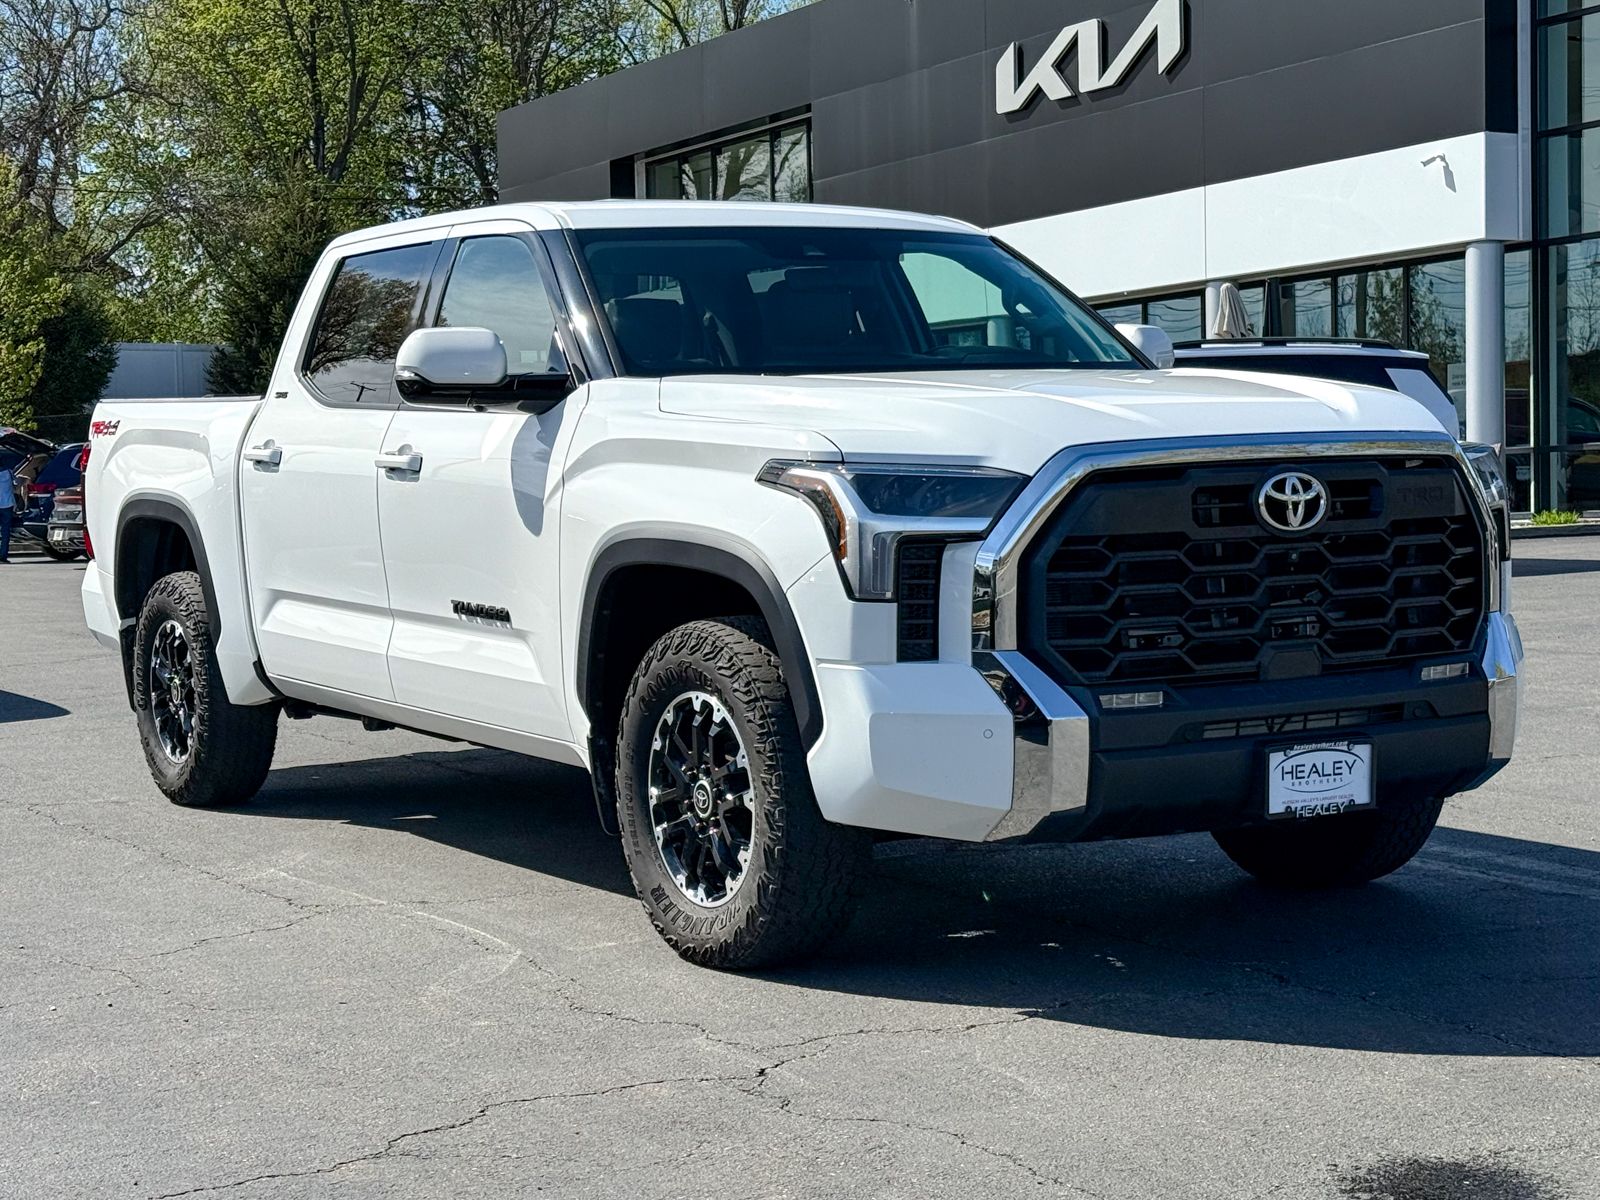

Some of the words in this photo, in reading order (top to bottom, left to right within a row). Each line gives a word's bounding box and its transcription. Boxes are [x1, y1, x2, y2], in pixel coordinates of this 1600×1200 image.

[996, 0, 1184, 114] KIA
[450, 599, 510, 623] TUNDRA
[1281, 759, 1357, 781] HEALEY
[1296, 803, 1346, 818] HEALEY
